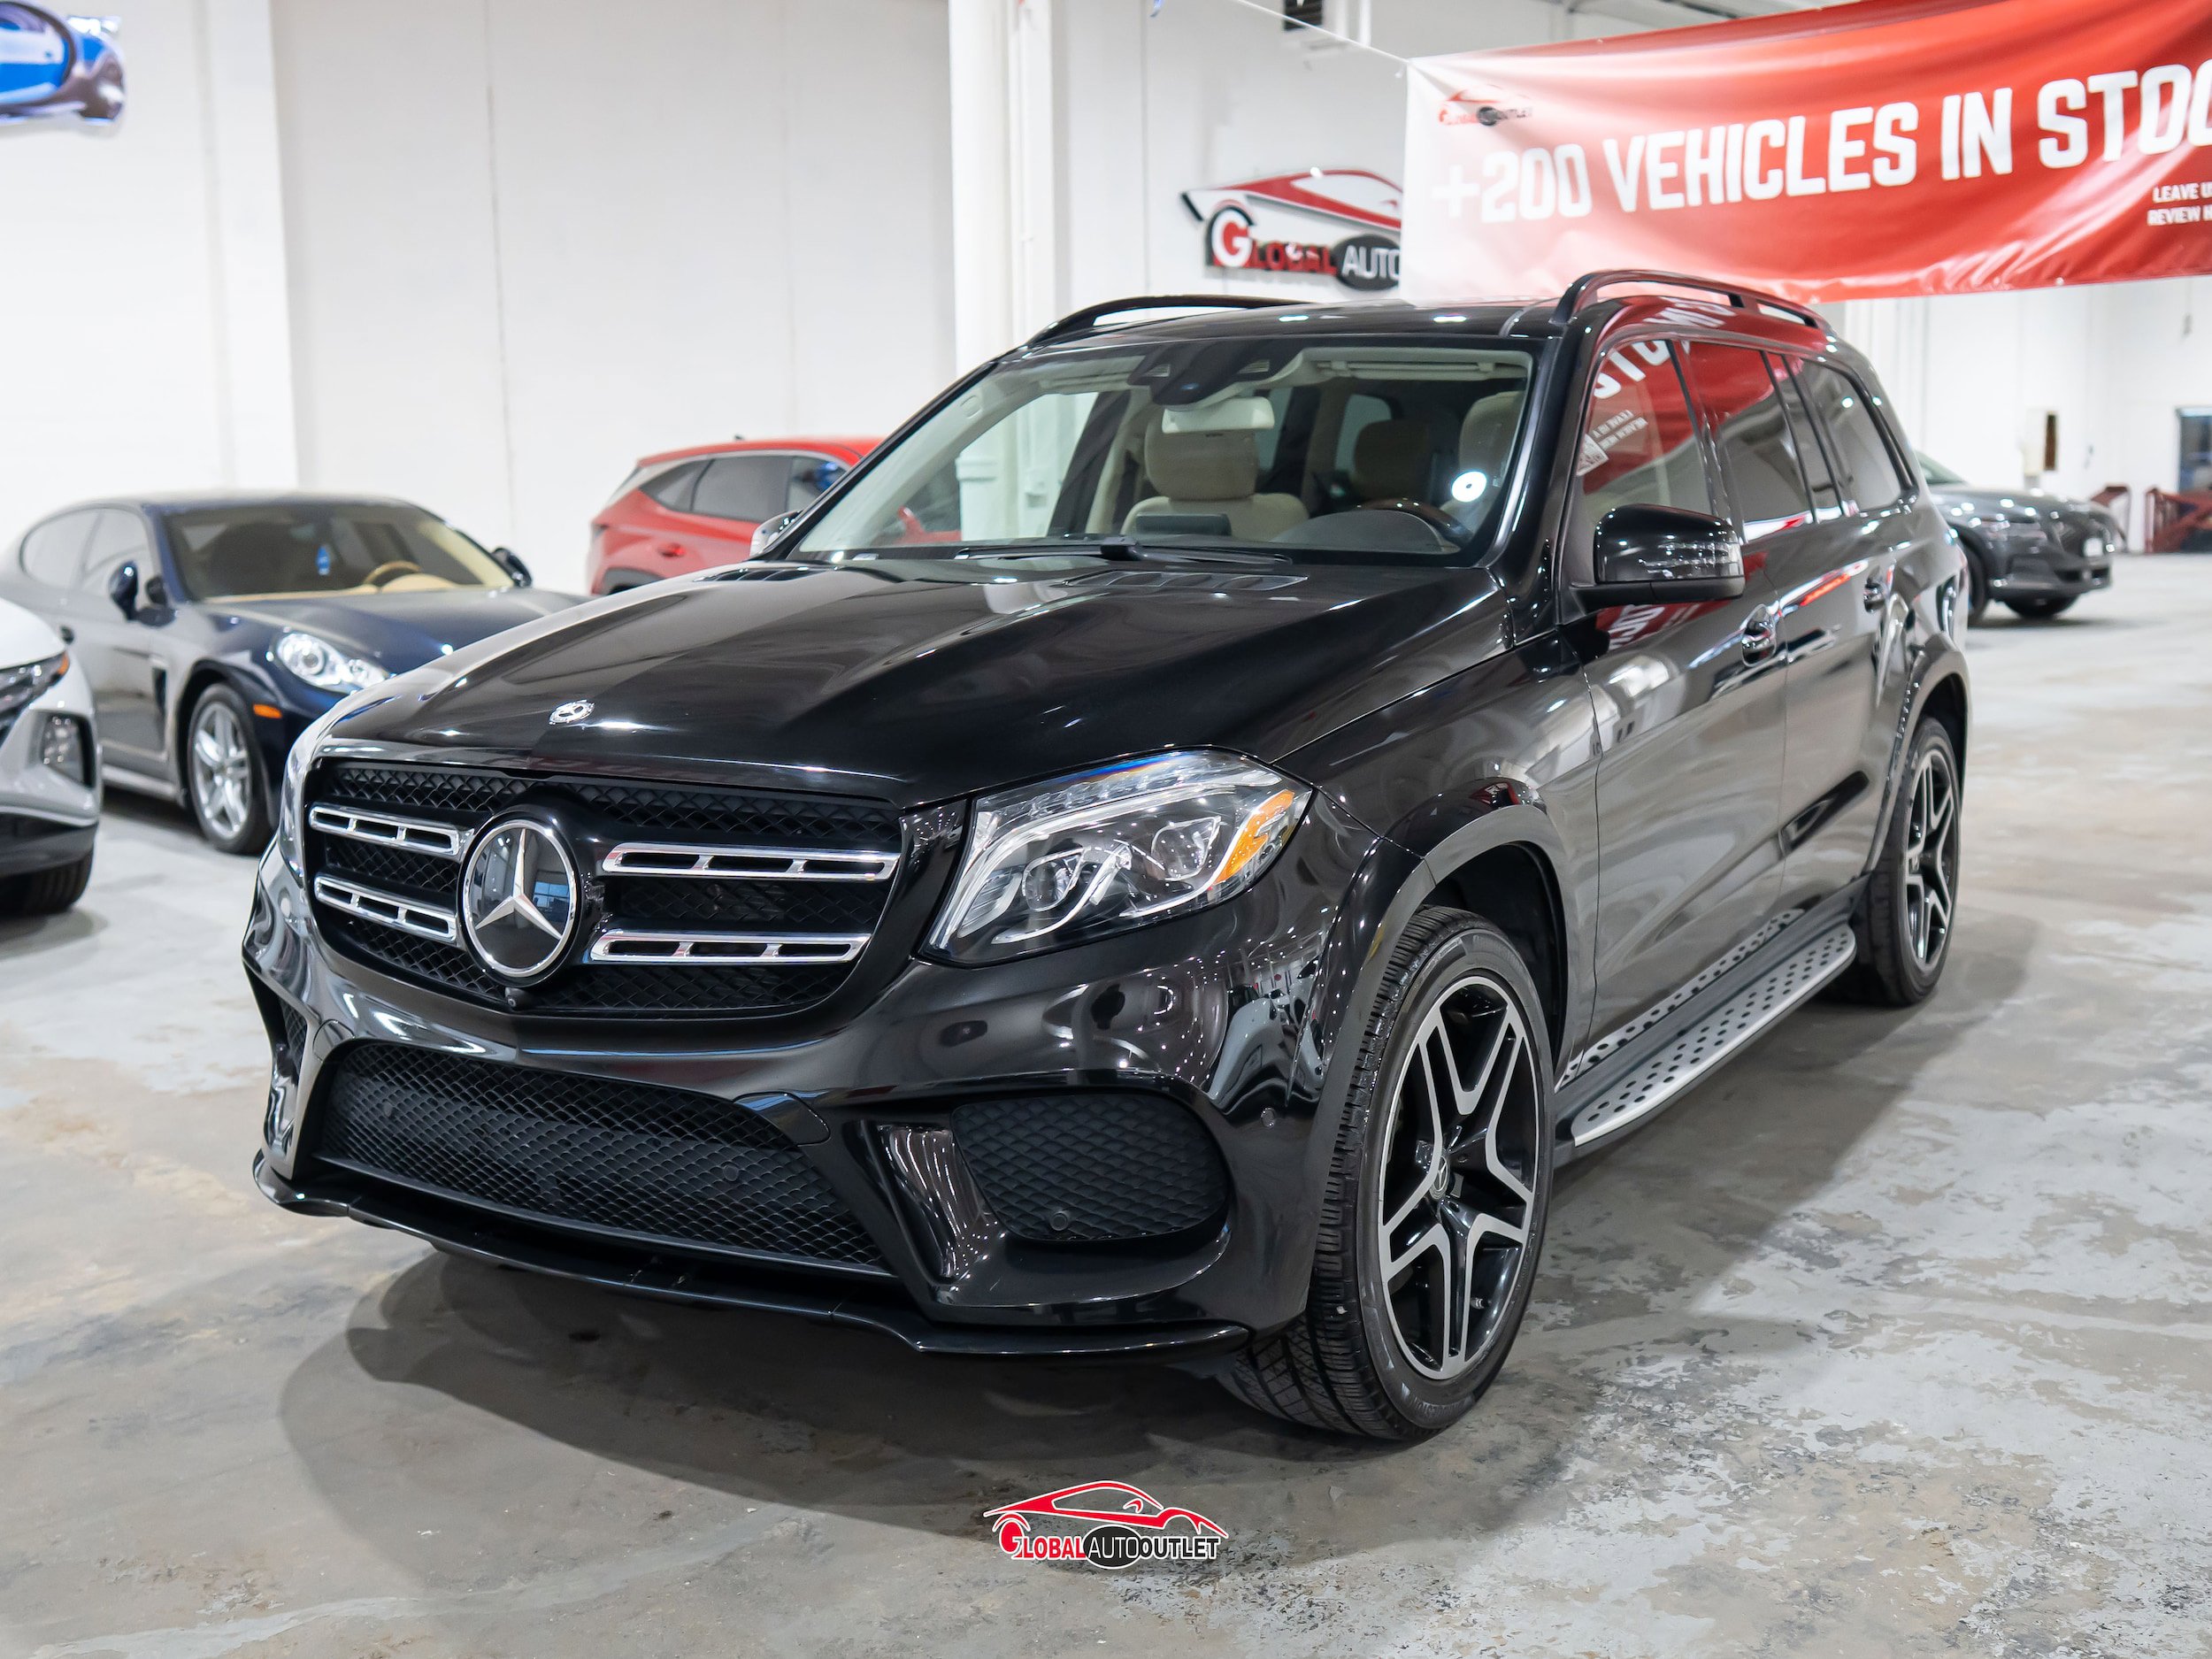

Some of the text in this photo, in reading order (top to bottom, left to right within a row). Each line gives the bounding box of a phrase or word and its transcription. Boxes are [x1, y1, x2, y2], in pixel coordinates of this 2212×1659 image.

[1431, 143, 1592, 222] +200
[1602, 102, 1919, 212] VEHICLES
[1941, 87, 2013, 180] IN
[2153, 182, 2200, 204] LEAVE
[2147, 205, 2200, 227] REVIEW
